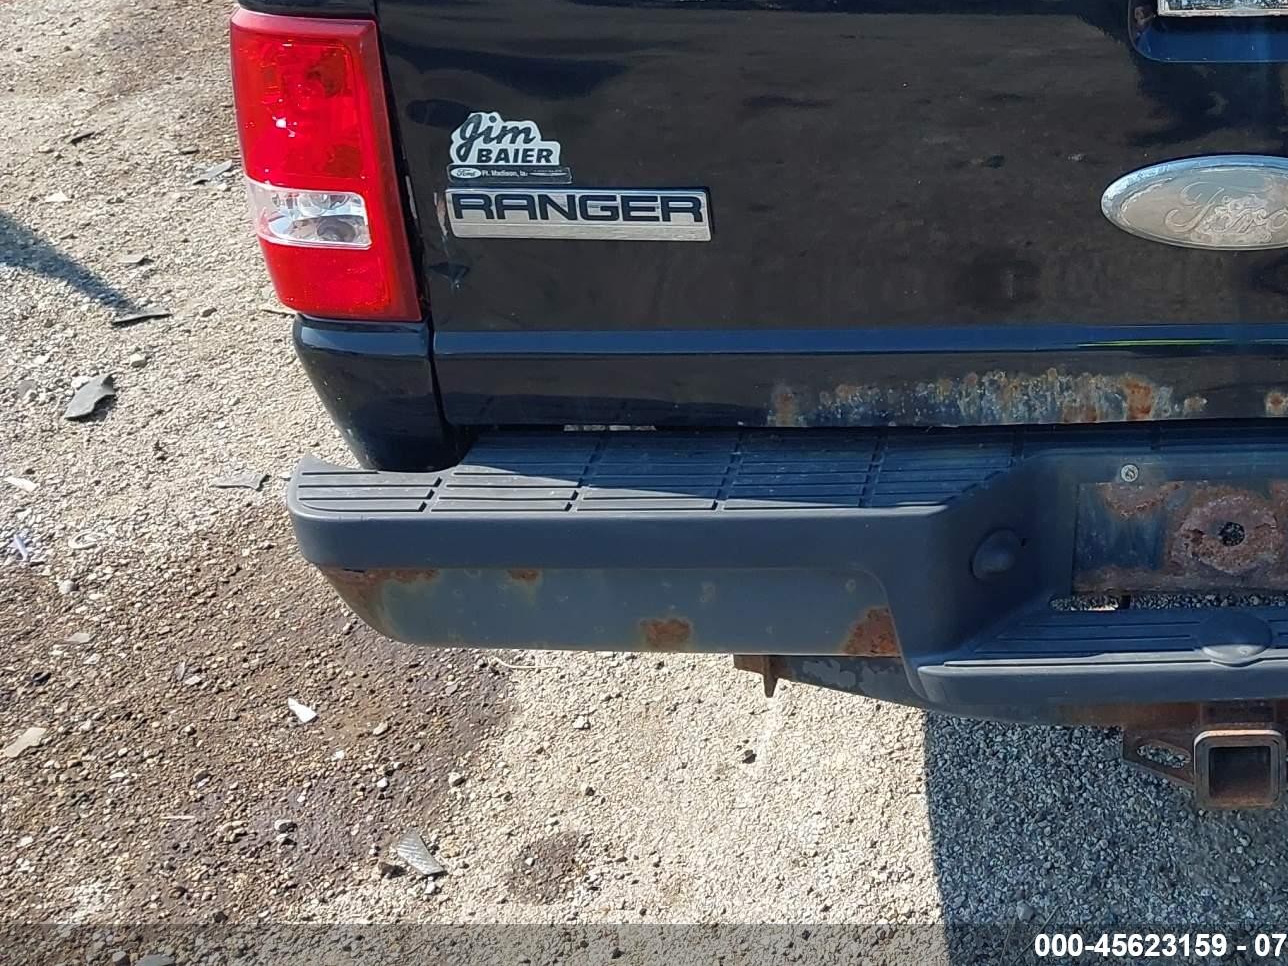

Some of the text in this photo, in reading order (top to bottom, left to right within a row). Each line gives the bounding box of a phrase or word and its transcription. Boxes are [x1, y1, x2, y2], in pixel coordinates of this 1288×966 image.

[456, 113, 537, 162] Jim
[476, 147, 553, 164] BAIER
[451, 193, 704, 223] RANGER
